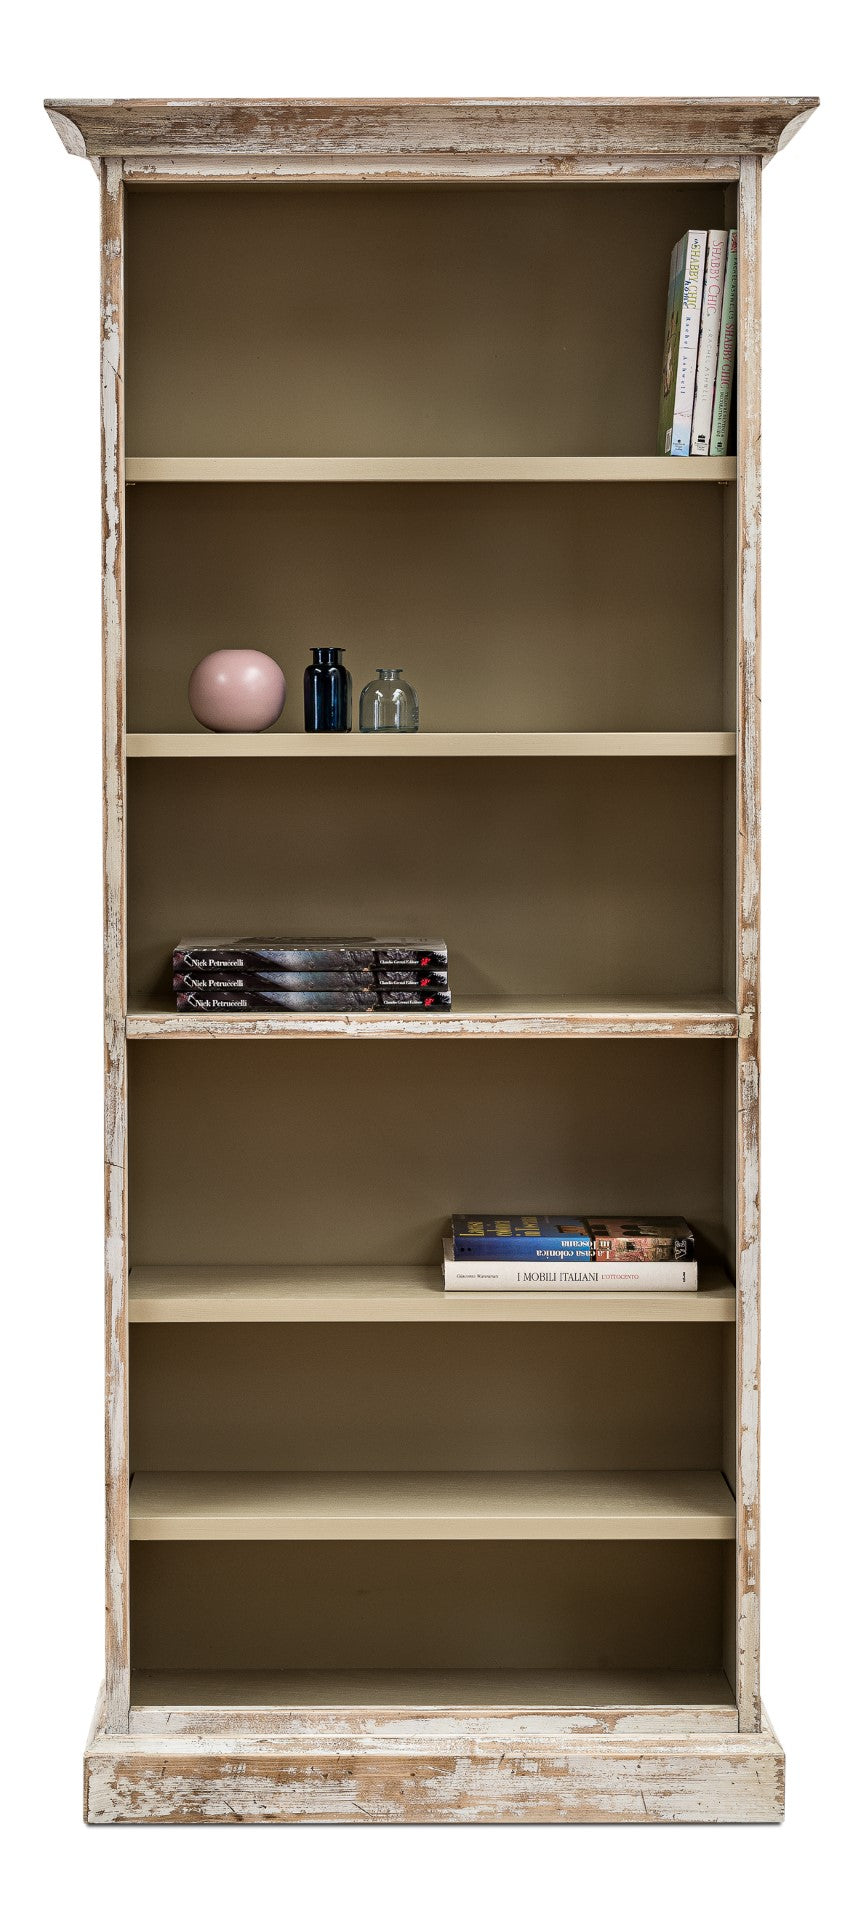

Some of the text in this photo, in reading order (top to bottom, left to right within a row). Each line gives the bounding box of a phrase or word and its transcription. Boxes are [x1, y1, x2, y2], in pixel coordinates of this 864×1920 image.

[689, 244, 700, 283] SHABBY
[709, 240, 724, 282] SHABBY
[682, 280, 692, 309] home
[687, 285, 697, 309] CHIC
[722, 323, 735, 363] SHABBY
[191, 959, 244, 967] Nick Petruccelli
[191, 979, 244, 987] Nick Petruccelli
[195, 999, 248, 1007] Nick Petruccelli
[561, 1241, 610, 1250] in Toscana
[536, 1250, 574, 1260] colonica
[597, 1250, 610, 1260] La
[517, 1272, 521, 1282] I
[523, 1272, 557, 1282] MOBILI
[559, 1272, 599, 1282] ITALIANI
